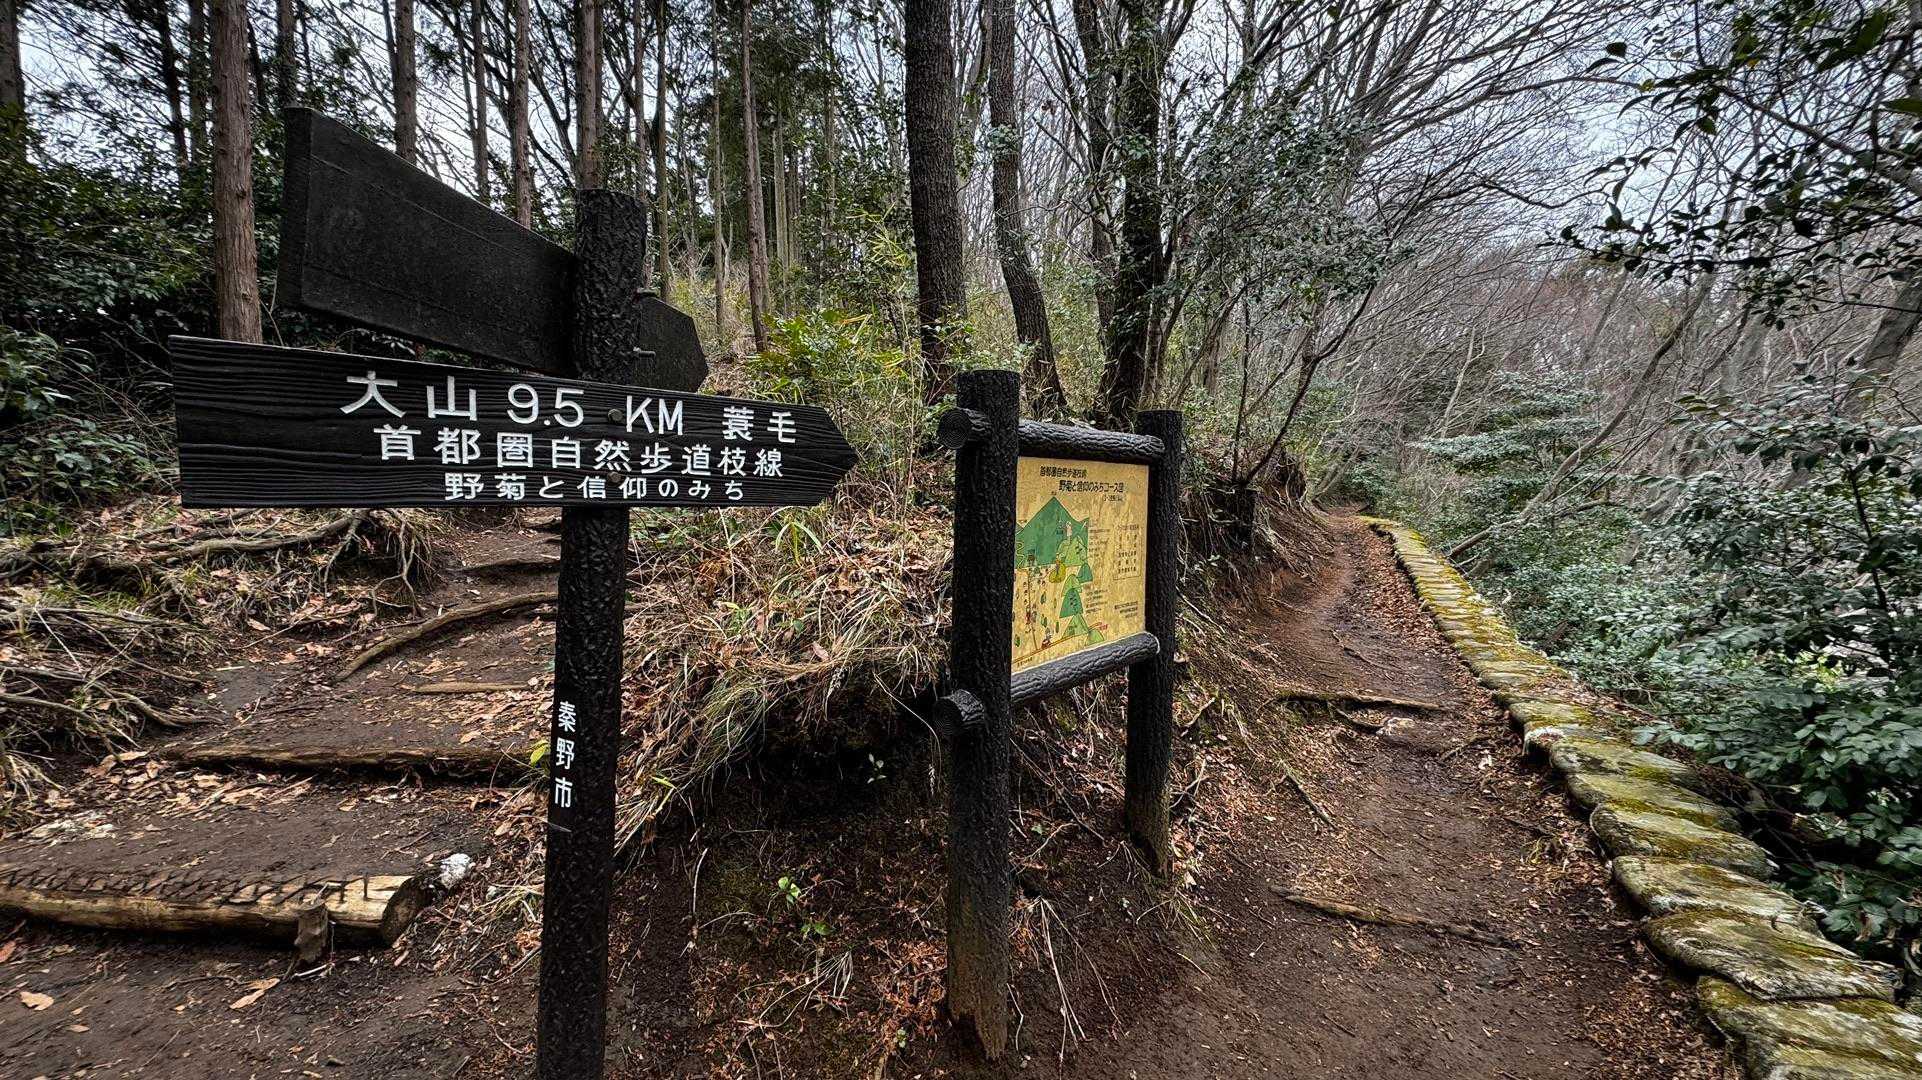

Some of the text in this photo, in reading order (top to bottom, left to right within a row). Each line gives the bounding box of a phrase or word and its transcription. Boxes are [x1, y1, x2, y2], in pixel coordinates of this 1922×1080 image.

[340, 371, 797, 444] 大山 9.5 KM 蓑毛
[374, 423, 784, 477] 首都圏自然歩道枝線
[444, 472, 744, 501] 野菊と信仰のみち
[554, 700, 577, 808] 秦野市
